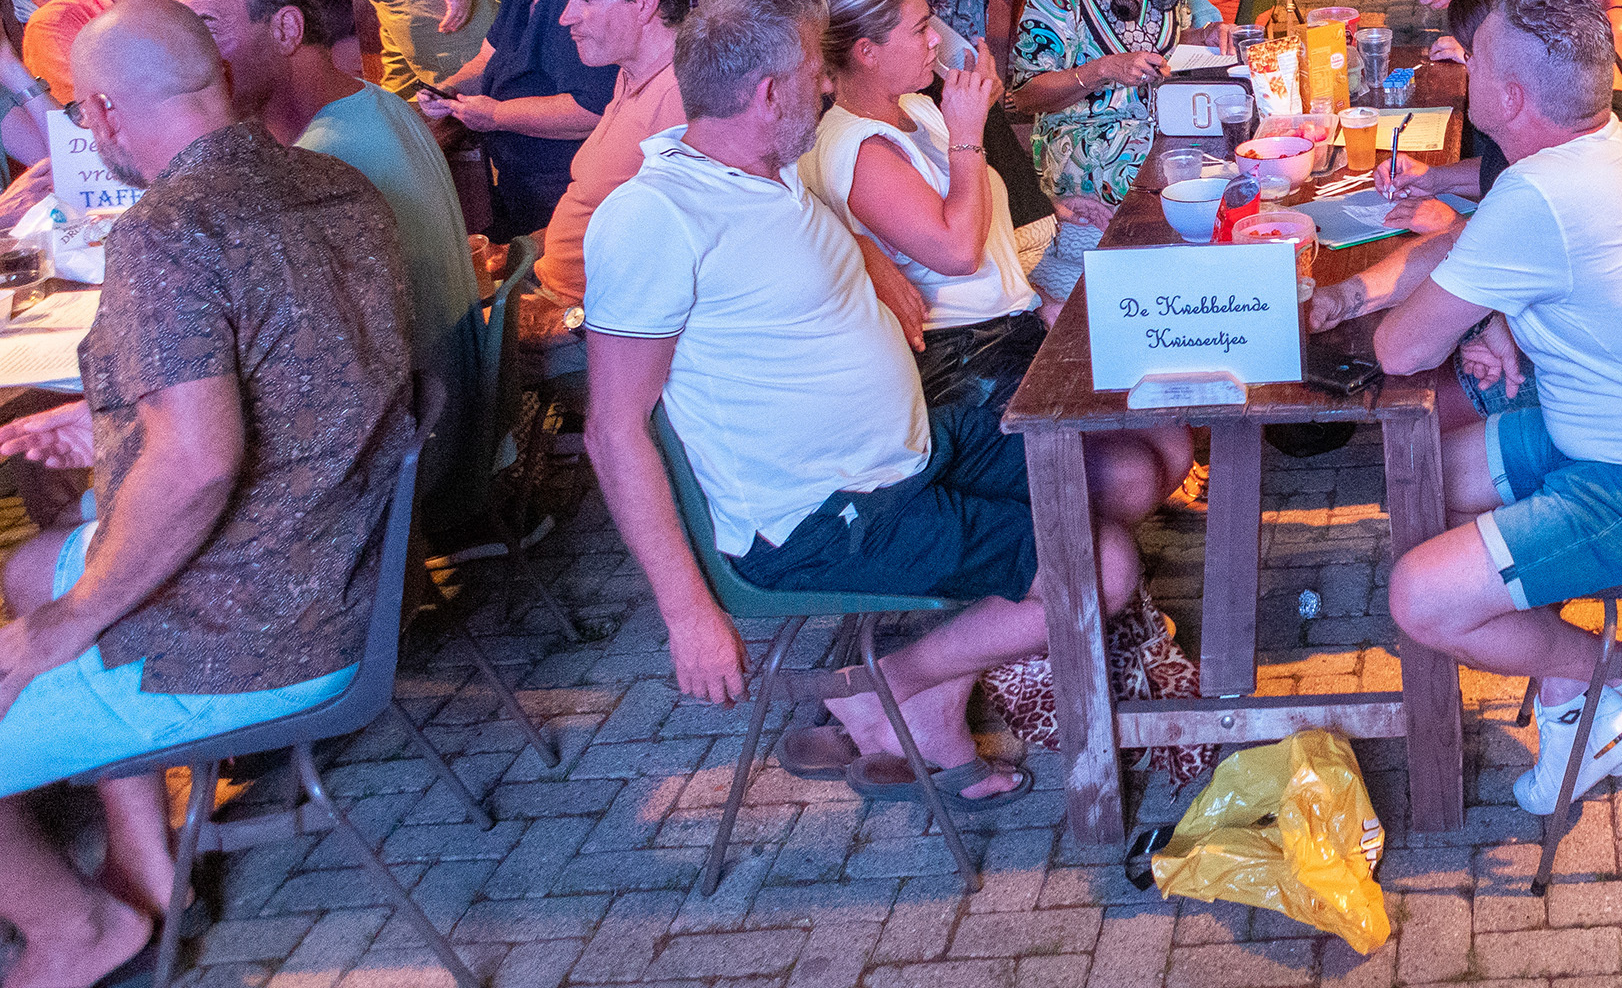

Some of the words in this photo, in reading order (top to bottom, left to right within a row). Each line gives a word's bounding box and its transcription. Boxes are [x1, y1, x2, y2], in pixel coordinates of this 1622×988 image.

[68, 137, 98, 154] De
[1119, 297, 1150, 318] De
[1155, 294, 1270, 316] Kwebbelende
[1145, 327, 1249, 354] Kwissertjes
